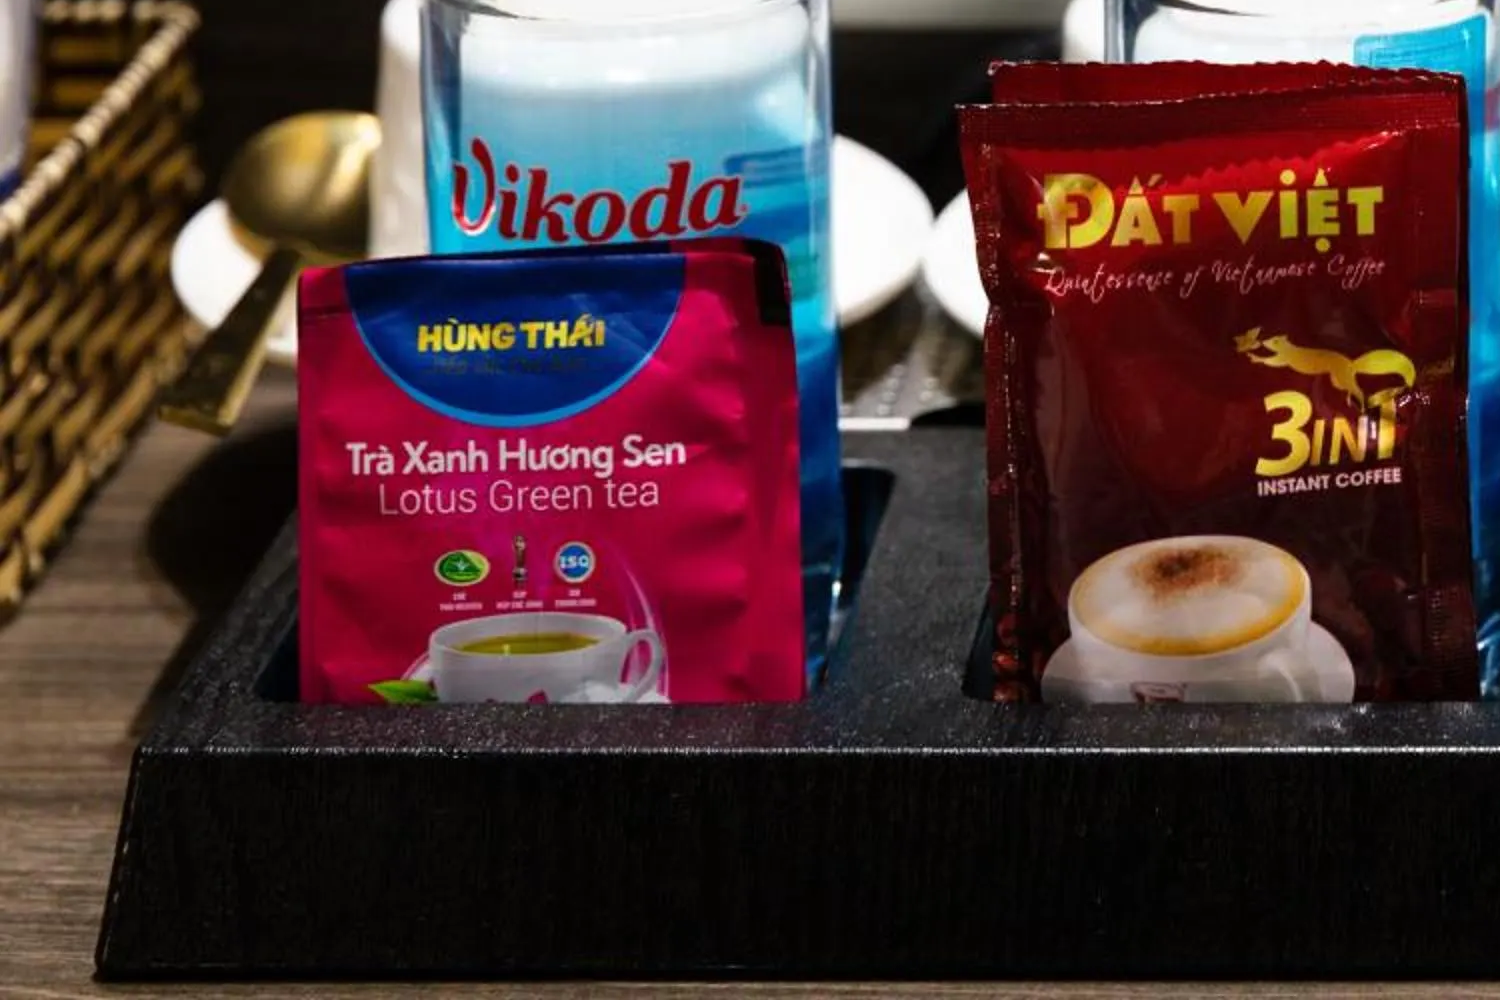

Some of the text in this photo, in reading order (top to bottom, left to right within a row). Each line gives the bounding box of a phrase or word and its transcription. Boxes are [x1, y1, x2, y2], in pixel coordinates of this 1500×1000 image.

[452, 136, 742, 243] Vikoda
[1037, 172, 1200, 249] ĐẤT
[1327, 254, 1386, 290] Coffee
[418, 313, 606, 352] HÙNG THÁI
[346, 434, 687, 478] Trà Xanh Hương Sen
[379, 478, 660, 515] Lotus Green tea
[1257, 467, 1402, 497] INSTANT COFFEE
